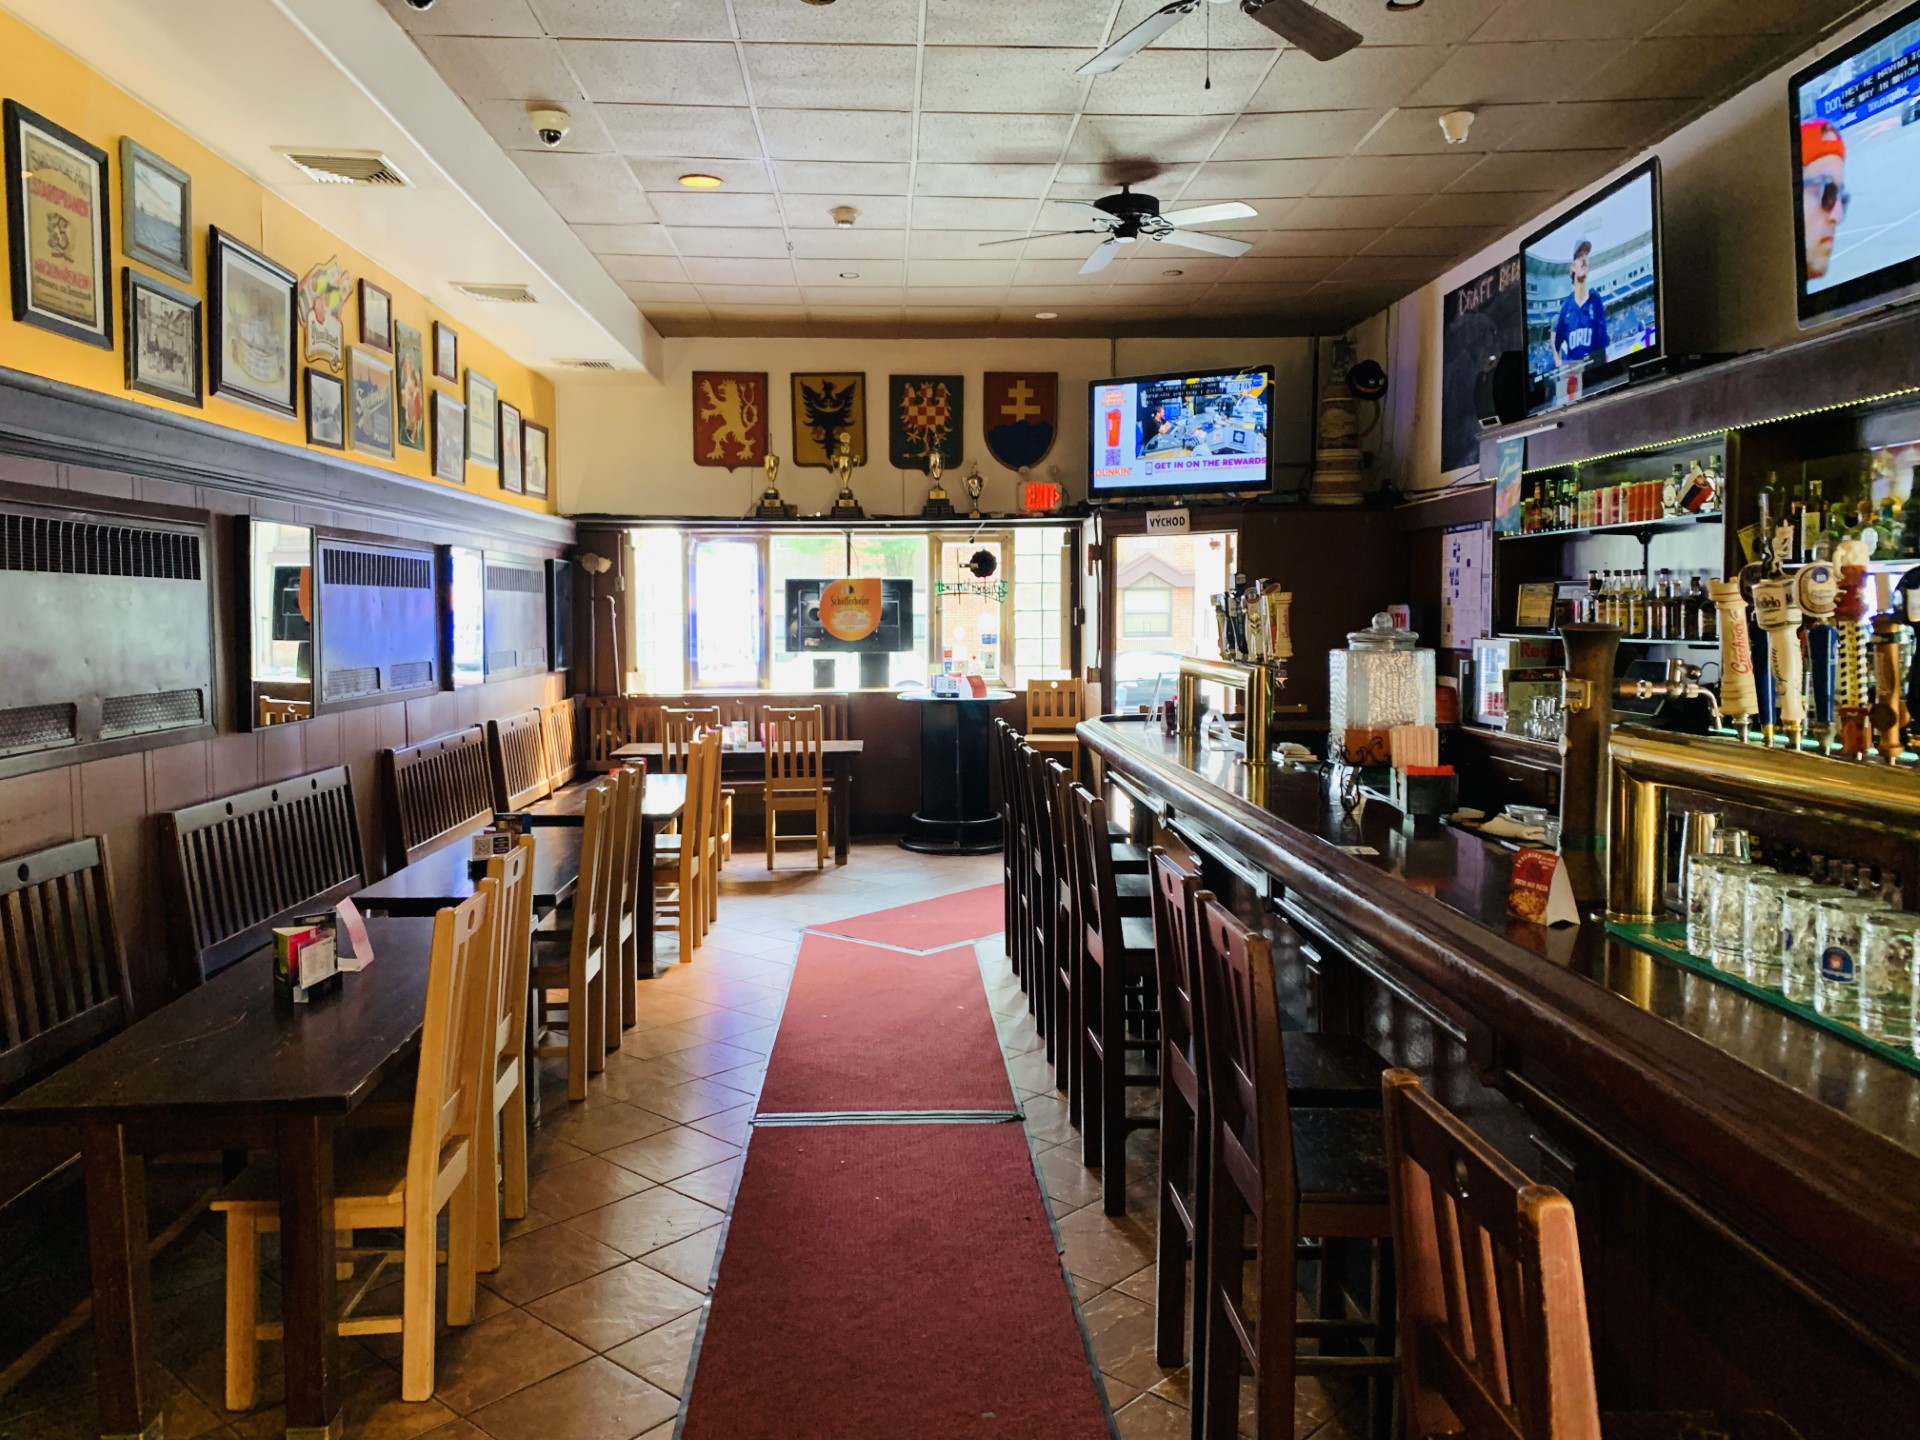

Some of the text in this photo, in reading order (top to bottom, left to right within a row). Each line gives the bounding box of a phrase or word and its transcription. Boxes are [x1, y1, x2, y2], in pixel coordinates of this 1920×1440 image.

[1877, 56, 1909, 80] HAVING
[1841, 64, 1919, 112] THE WAY IN WHICH
[1458, 275, 1494, 316] DRAFT
[1154, 457, 1267, 470] GET IN ON THE REWARDS
[1025, 482, 1056, 509] EXIT
[1149, 514, 1186, 528] VÝCHOD
